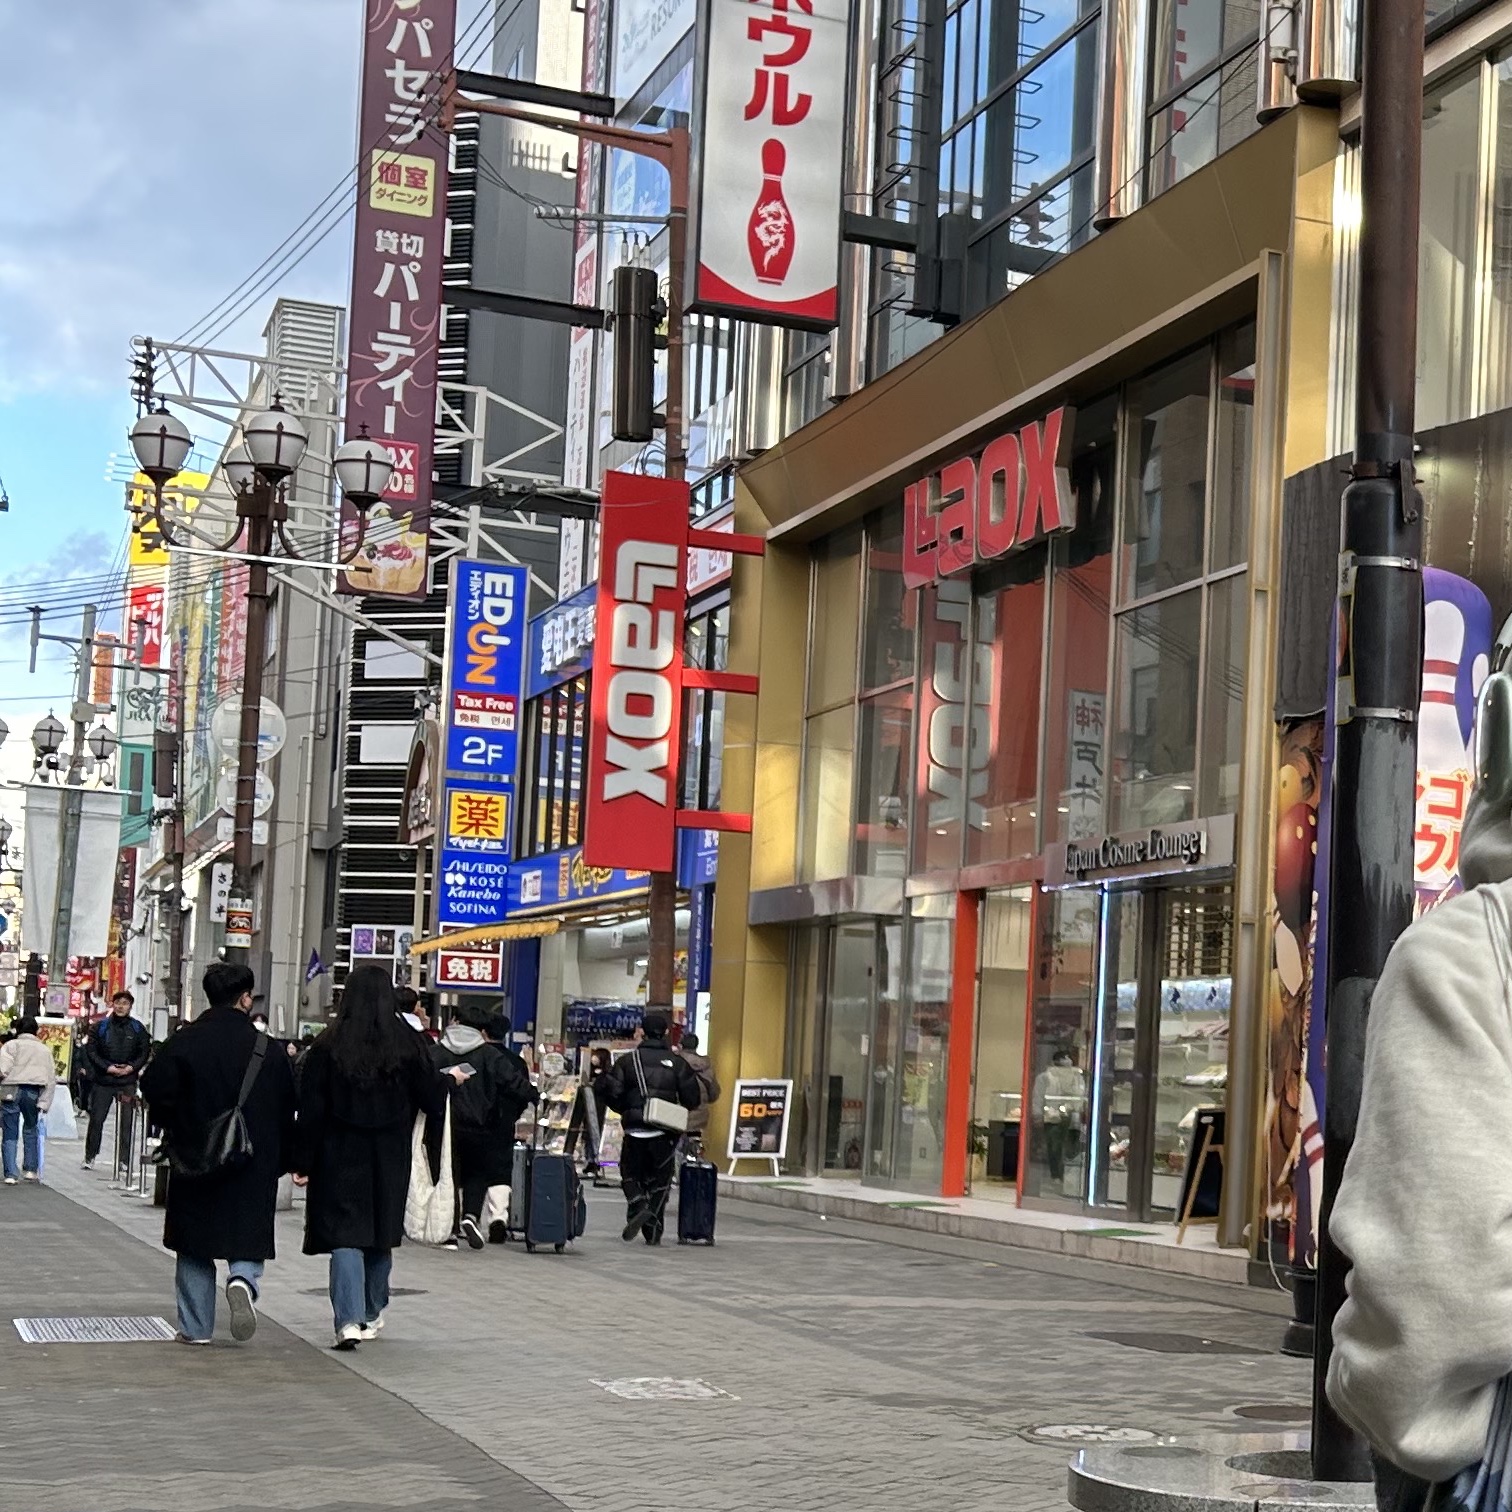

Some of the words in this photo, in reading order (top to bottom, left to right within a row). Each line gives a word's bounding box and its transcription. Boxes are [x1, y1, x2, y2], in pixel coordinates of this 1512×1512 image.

[384, 17, 434, 144] パセラ
[377, 161, 428, 190] 個室
[375, 187, 428, 206] ダイニング
[375, 228, 425, 259] 貸切
[372, 260, 421, 435] パーティー
[387, 446, 414, 471] AX
[466, 570, 482, 621] エディオン
[465, 571, 514, 686] EDION
[457, 694, 482, 708] Tax
[485, 697, 514, 711] Free
[462, 736, 503, 765] 2F
[456, 795, 500, 837] 薬
[1100, 835, 1144, 867] Cosme
[1147, 829, 1200, 864] Lounge
[443, 859, 508, 875] SHISEIDO
[447, 885, 501, 900] Kanebo
[449, 901, 498, 915] SOFINA
[447, 957, 492, 981] 免税
